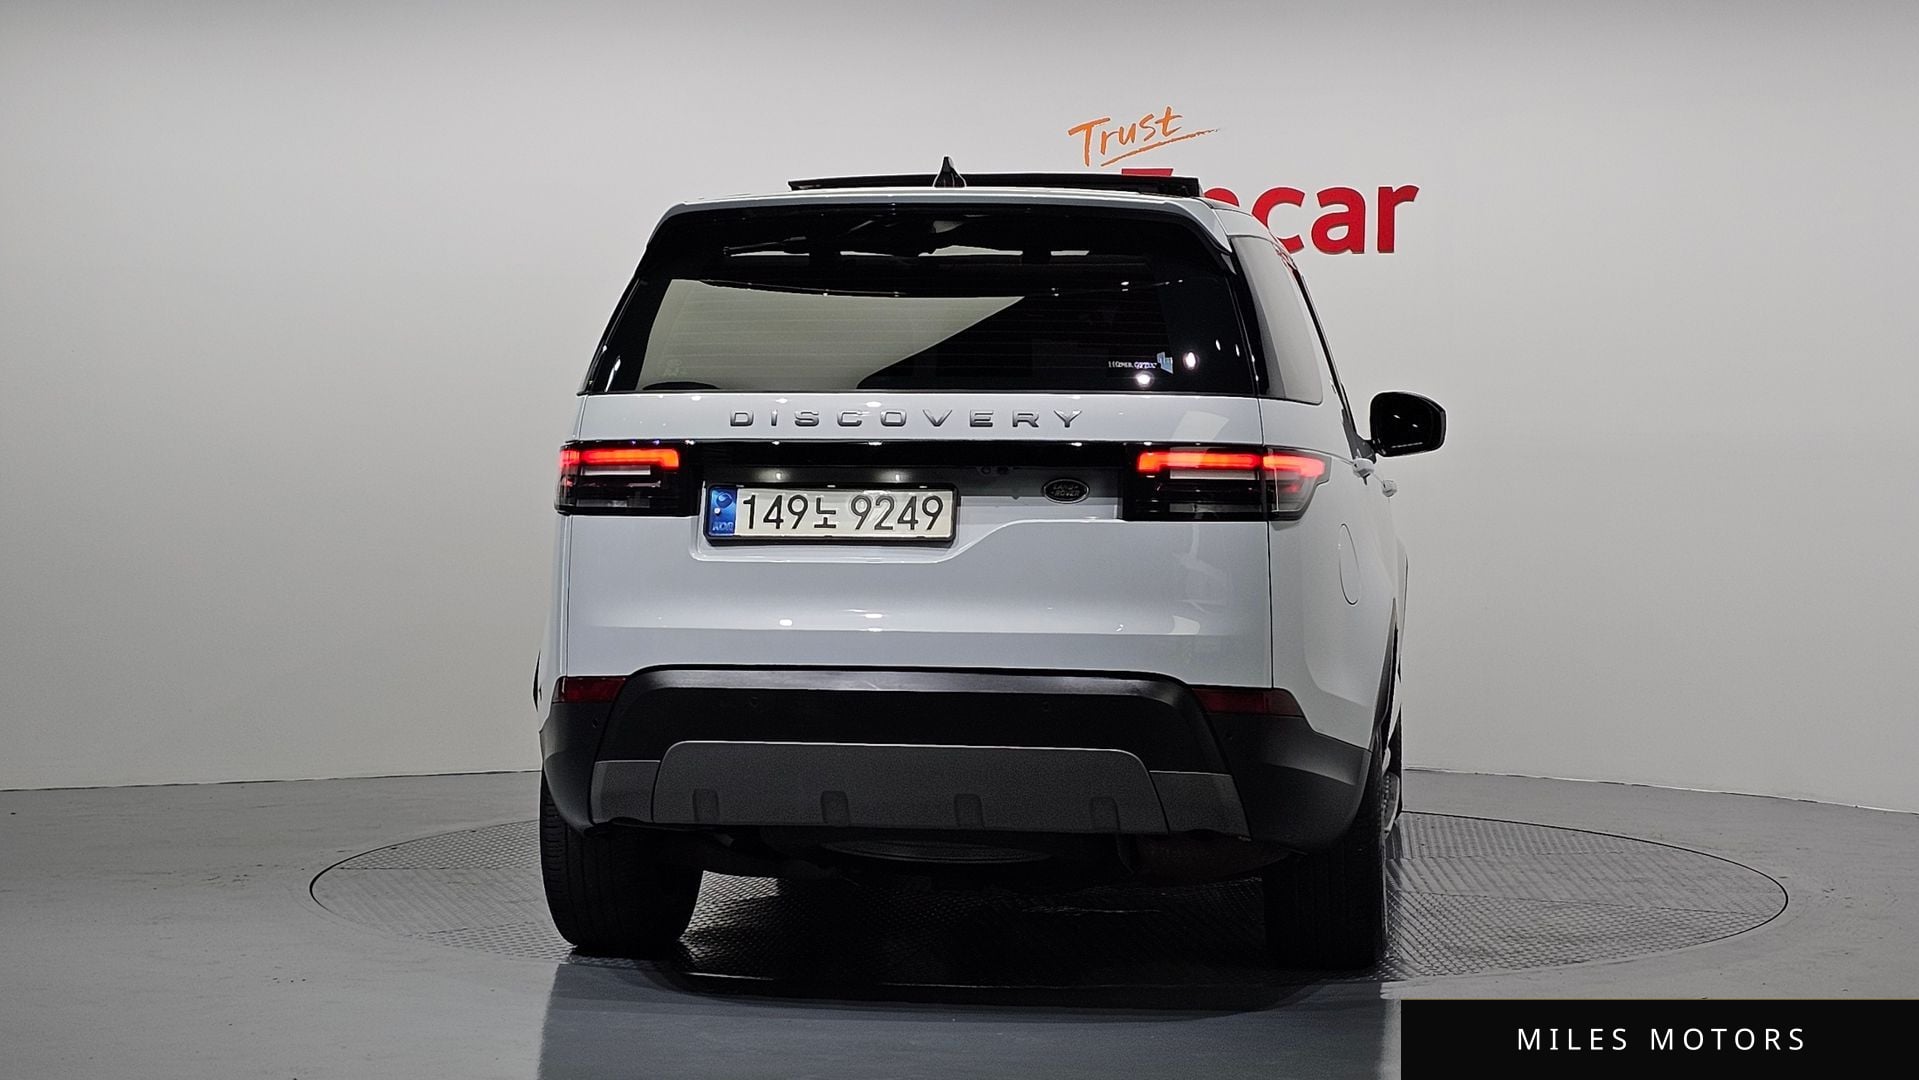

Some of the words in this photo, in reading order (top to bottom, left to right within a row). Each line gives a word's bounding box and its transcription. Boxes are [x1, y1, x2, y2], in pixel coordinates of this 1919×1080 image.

[1067, 105, 1184, 167] Trust
[1121, 168, 1420, 254] car
[729, 409, 1084, 428] DISCOVERY
[742, 493, 837, 530] 149노
[850, 494, 945, 531] 9249
